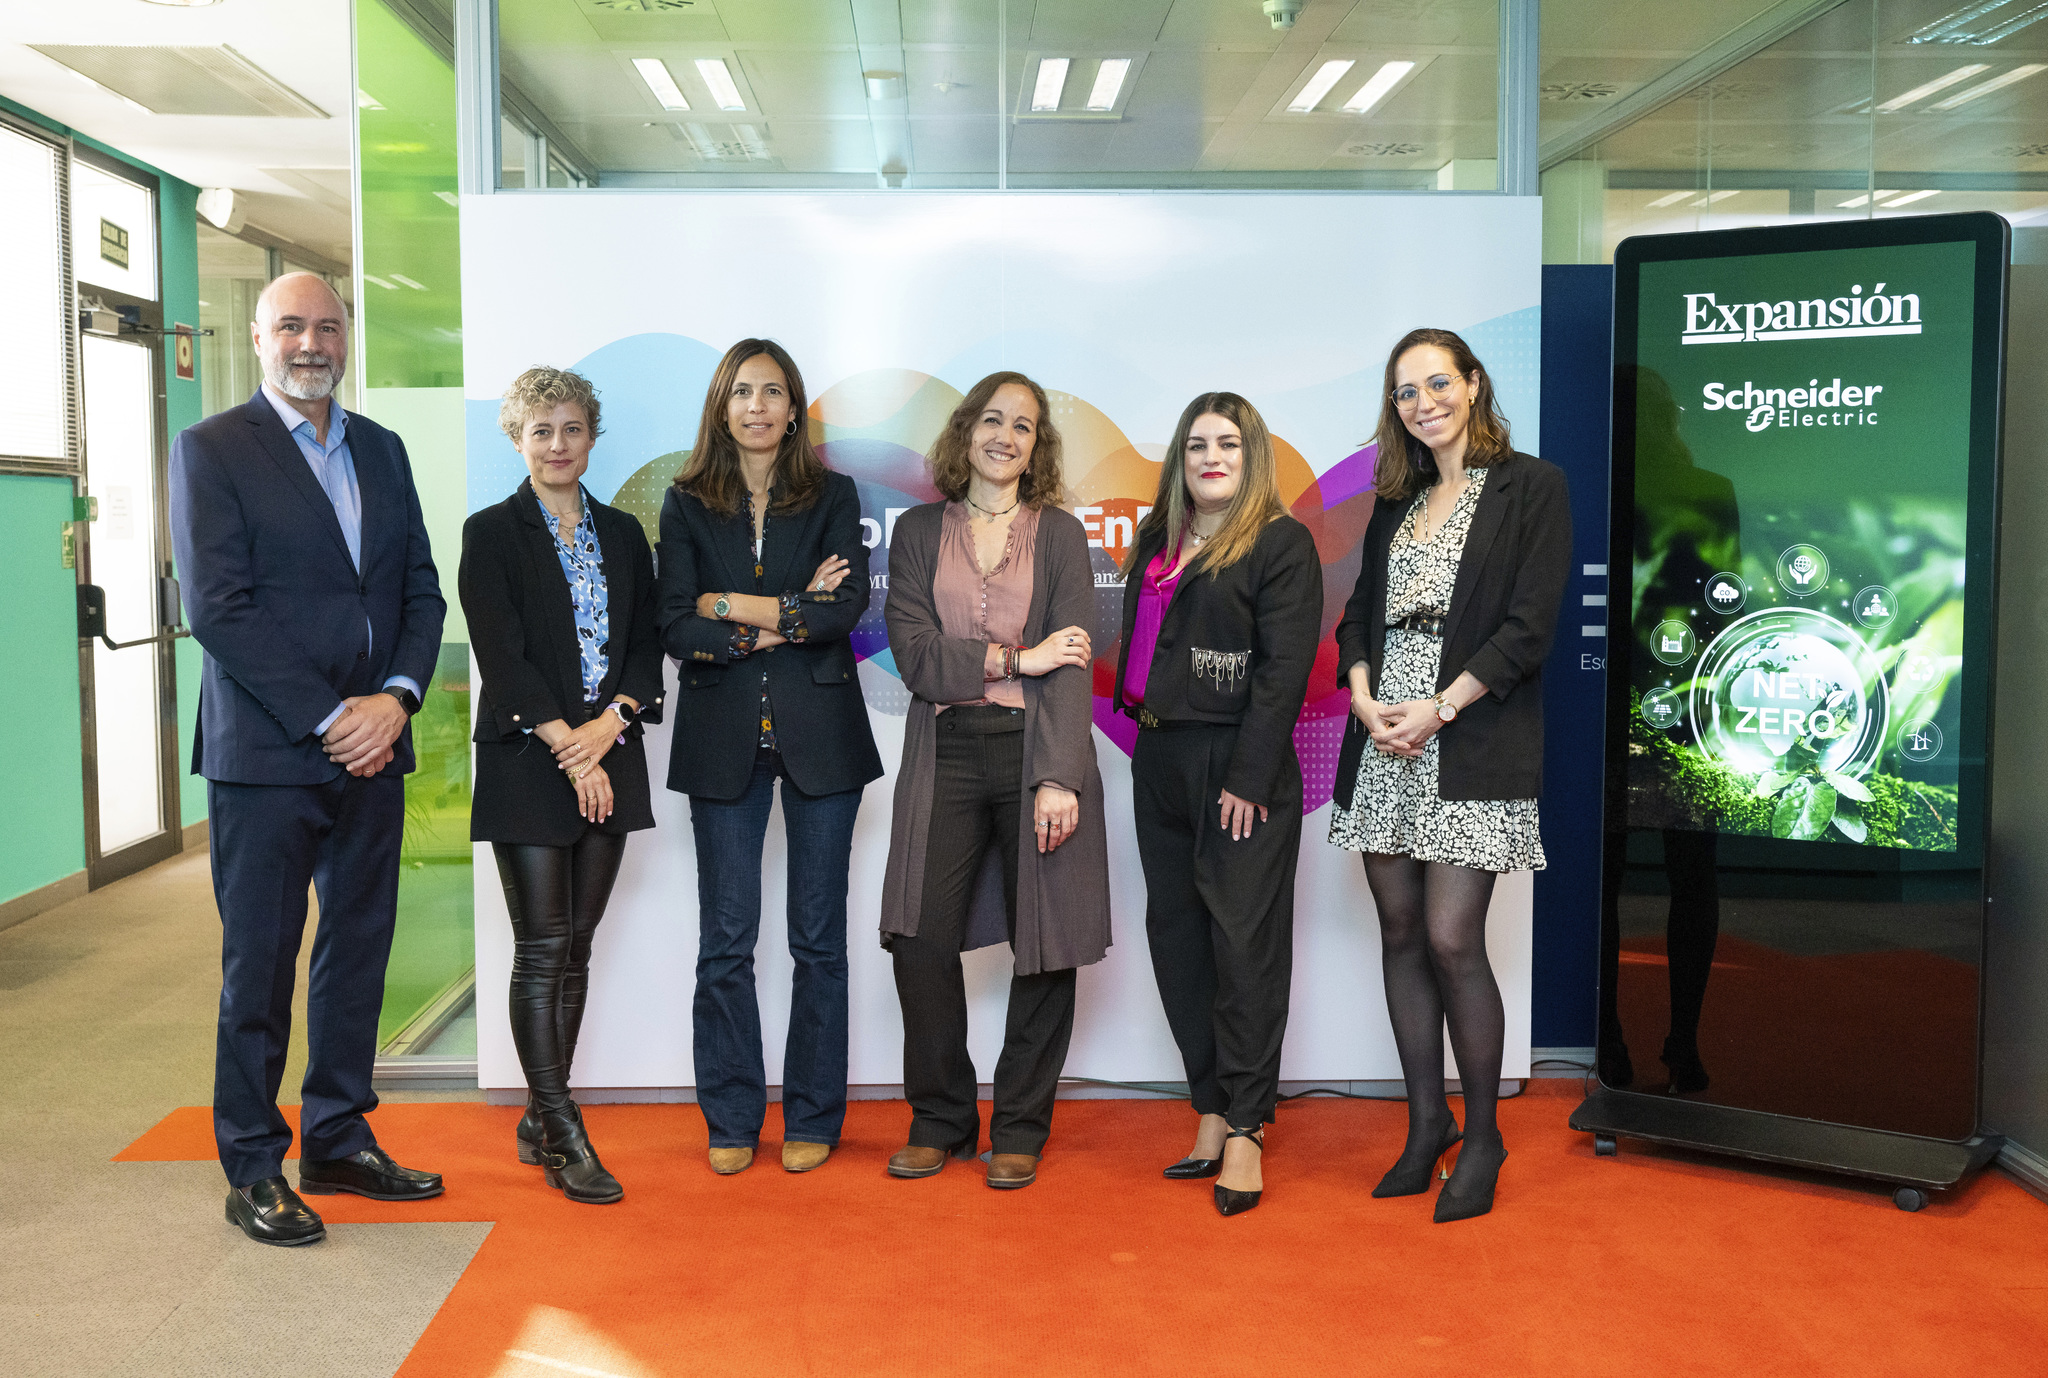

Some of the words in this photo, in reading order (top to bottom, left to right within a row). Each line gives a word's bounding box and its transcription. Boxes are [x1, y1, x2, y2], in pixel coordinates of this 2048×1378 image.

[1682, 283, 1923, 342] Expansión
[1703, 378, 1883, 411] Schneider
[1778, 409, 1878, 427] Electric
[1752, 671, 1824, 701] NET
[1735, 705, 1836, 738] ZERO
